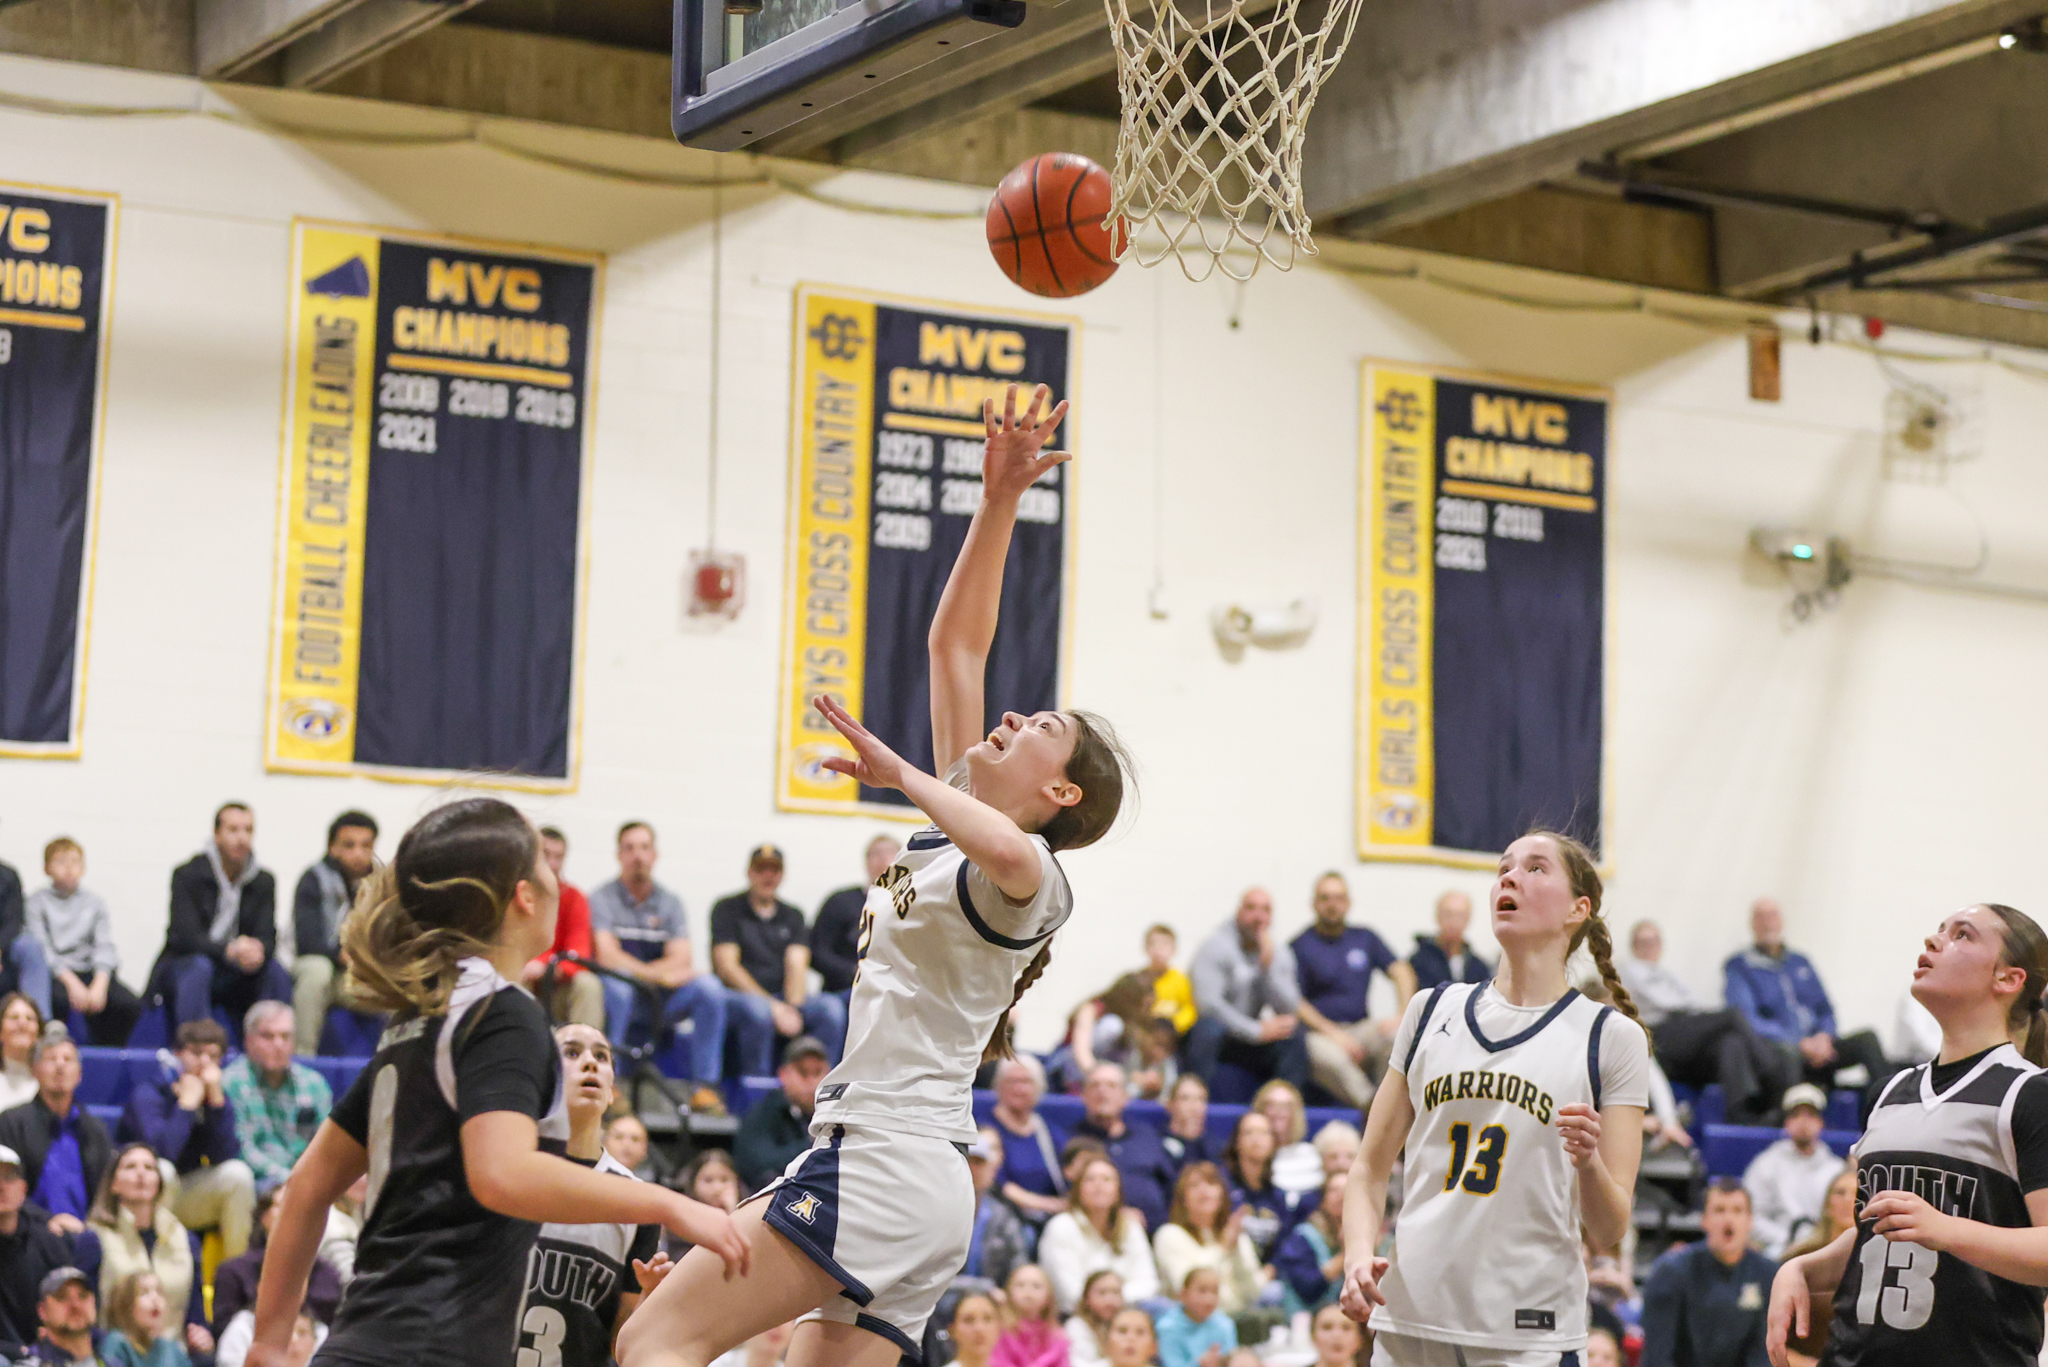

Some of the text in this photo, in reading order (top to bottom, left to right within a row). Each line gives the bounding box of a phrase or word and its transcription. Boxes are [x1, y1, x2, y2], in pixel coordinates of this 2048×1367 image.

[427, 257, 543, 313] MVC
[393, 305, 570, 368] CHAMPIONS
[918, 320, 1026, 375] MVC
[448, 377, 510, 419] 2018
[515, 385, 576, 430] 2019
[1470, 391, 1569, 445] MVC
[377, 411, 438, 455] 2021
[811, 370, 858, 522] COUNTRY
[875, 471, 933, 512] 2004
[1445, 435, 1595, 494] CHAMPIONS
[294, 314, 358, 687] FOOTBALL CHEERLEADING
[806, 529, 852, 640] CROSS
[1378, 437, 1421, 788] GIRLS CROSS COUNTRY
[1424, 1070, 1554, 1126] WARRIORS
[1442, 1120, 1510, 1198] 13
[785, 1190, 823, 1226] A
[1856, 1234, 1939, 1331] 13
